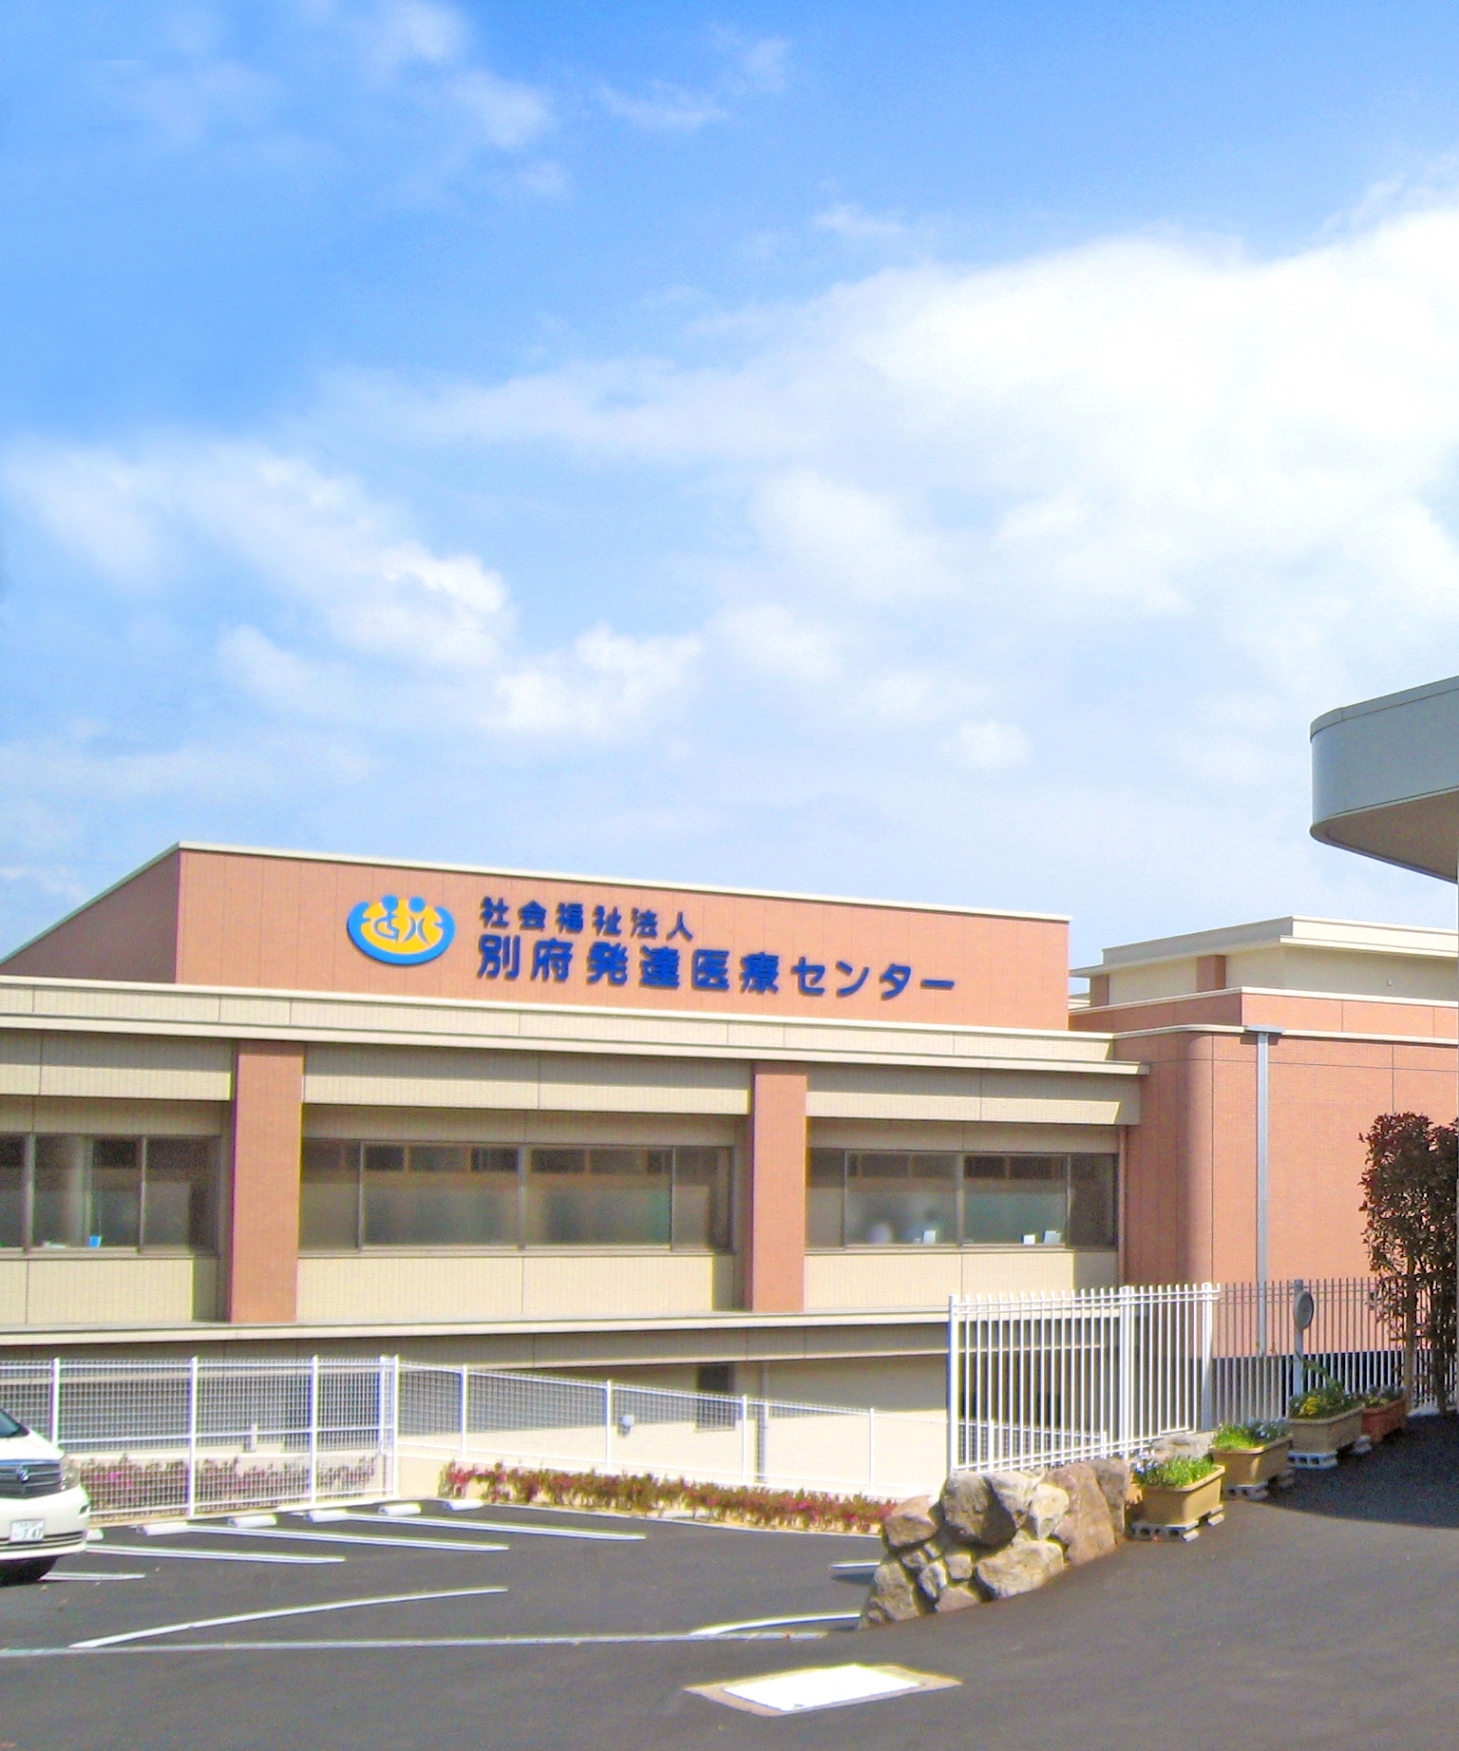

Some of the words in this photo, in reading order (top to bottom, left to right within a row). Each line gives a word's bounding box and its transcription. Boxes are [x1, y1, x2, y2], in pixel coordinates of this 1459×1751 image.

[479, 896, 694, 942] 社会福祉法人
[476, 934, 957, 1000] 別府発達医療センター
